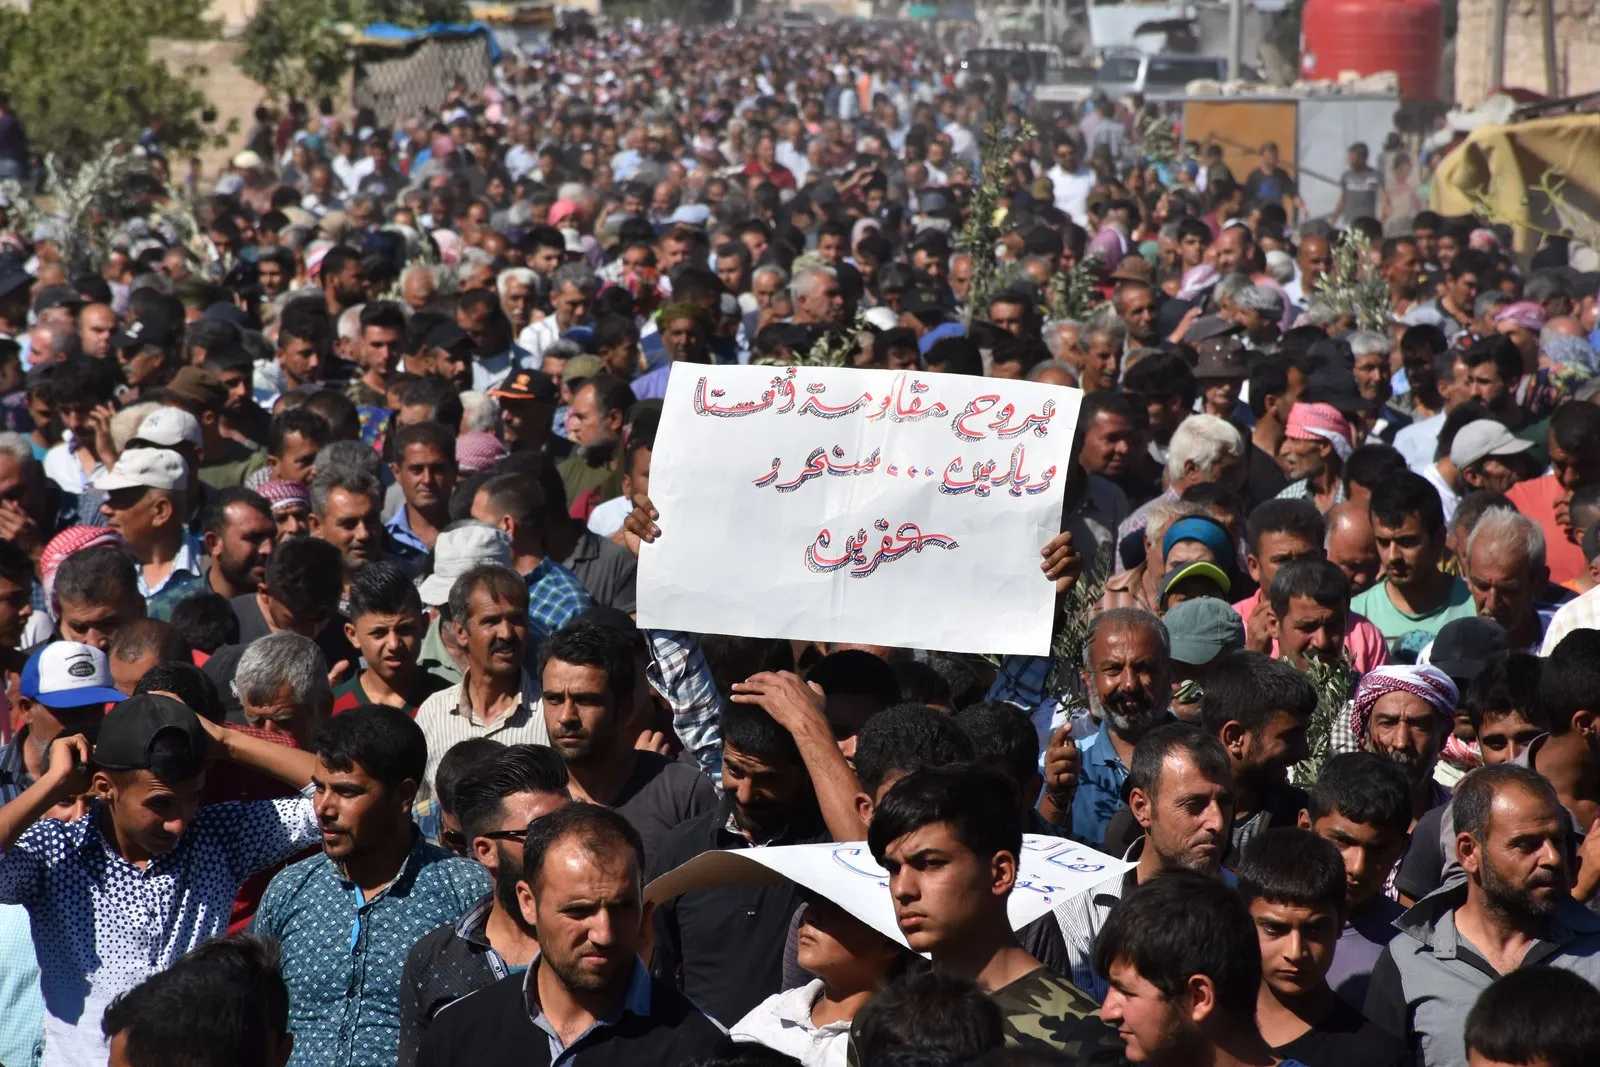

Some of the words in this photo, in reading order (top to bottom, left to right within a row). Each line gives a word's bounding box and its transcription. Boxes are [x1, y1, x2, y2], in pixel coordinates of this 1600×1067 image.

[797, 368, 949, 423] مقاومة
[949, 394, 1056, 442] بروح
[751, 444, 881, 493] سنحرر
[938, 442, 1057, 497] وبارين
[805, 518, 960, 579] عفرين
